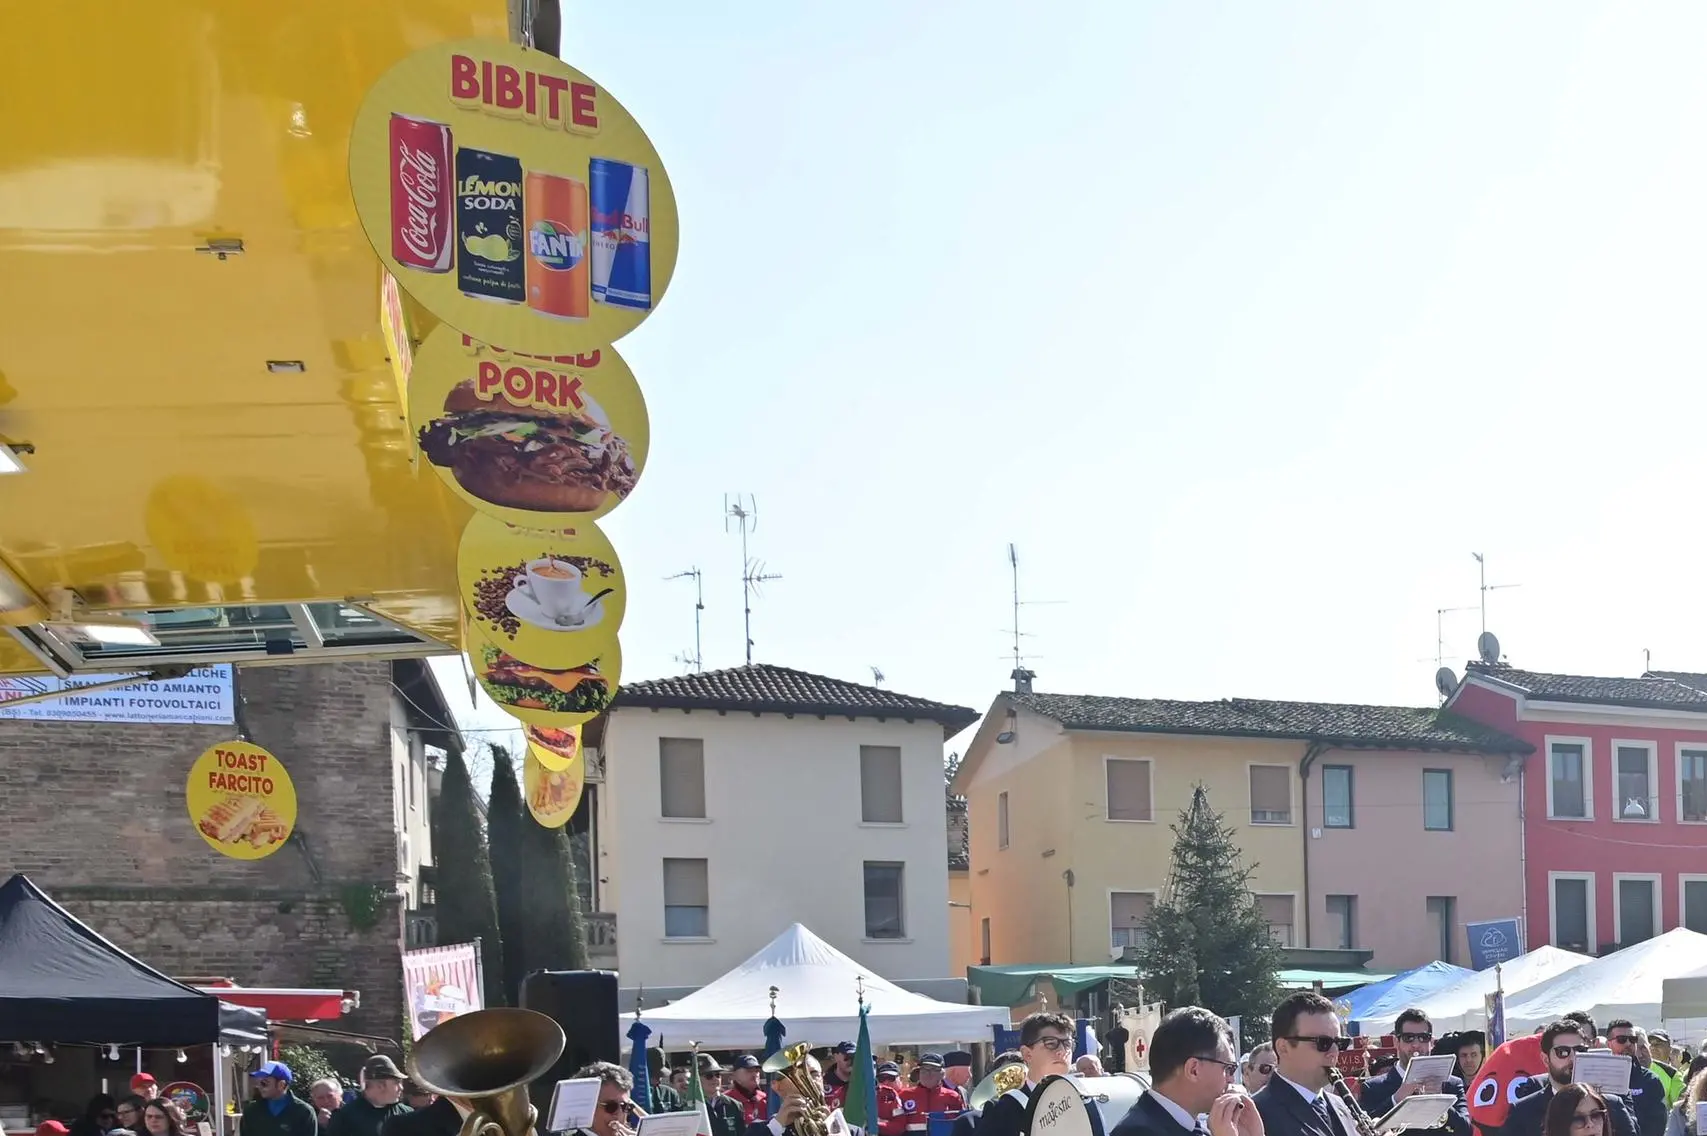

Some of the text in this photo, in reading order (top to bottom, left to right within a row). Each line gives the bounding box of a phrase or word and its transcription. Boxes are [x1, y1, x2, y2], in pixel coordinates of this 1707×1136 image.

[450, 54, 599, 129] BIBITE
[458, 175, 522, 198] LEMON
[464, 196, 517, 211] SODA
[478, 361, 584, 410] PORK
[163, 683, 222, 695] AMIANTO
[64, 697, 222, 710] IMPIANTI FOTOVOLTAICI
[215, 749, 268, 772] TOAST
[208, 771, 274, 795] FARCITO
[1039, 1096, 1072, 1130] majestic
